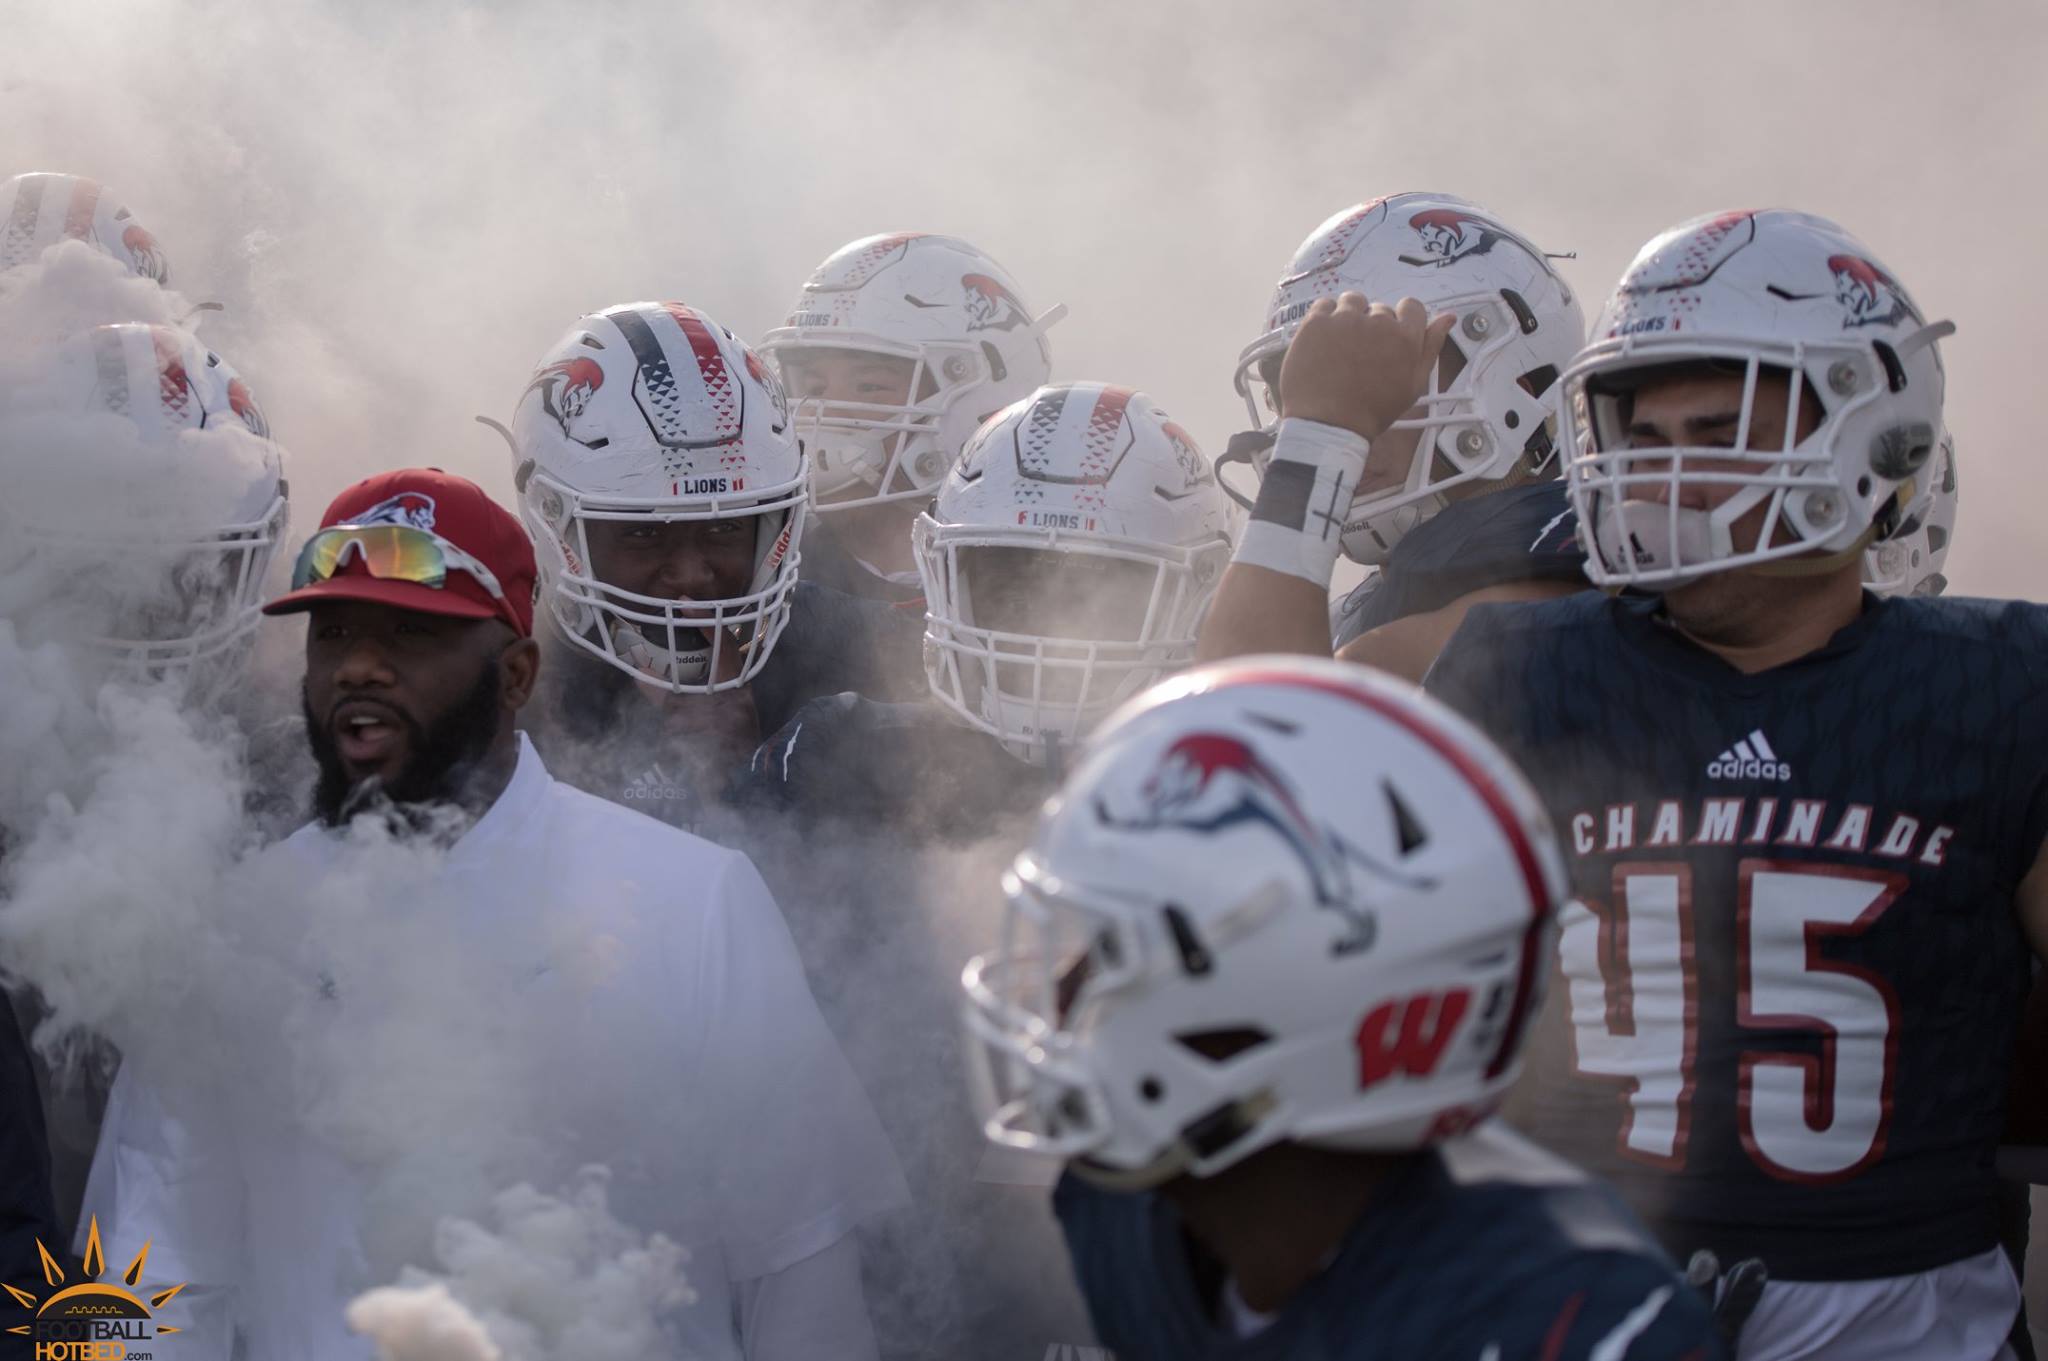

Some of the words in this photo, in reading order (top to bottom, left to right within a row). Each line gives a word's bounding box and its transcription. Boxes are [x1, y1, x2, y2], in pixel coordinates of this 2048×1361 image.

[683, 477, 727, 495] LIONS
[1032, 512, 1080, 530] LIONS
[1706, 759, 1792, 782] adidas
[623, 783, 690, 800] adidas
[1570, 797, 1955, 866] CHAMINADE
[1556, 858, 1909, 1185] 45
[1356, 983, 1471, 1092] W
